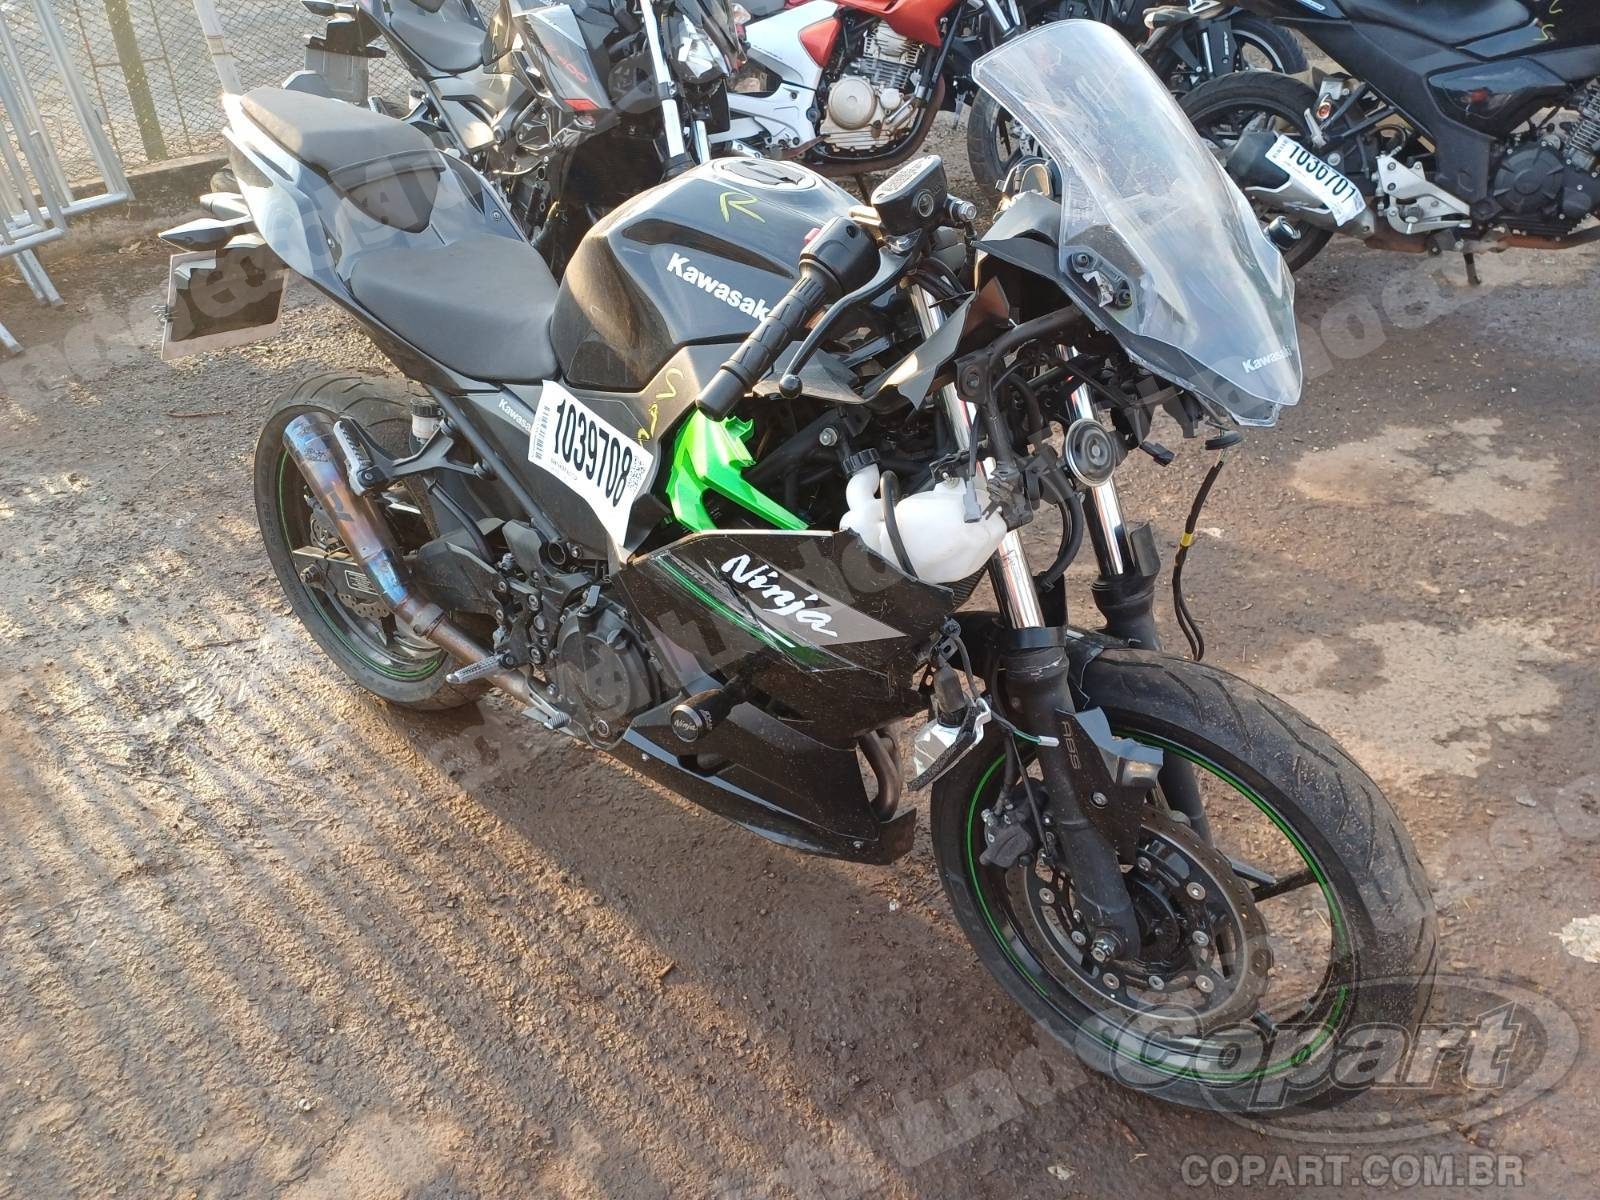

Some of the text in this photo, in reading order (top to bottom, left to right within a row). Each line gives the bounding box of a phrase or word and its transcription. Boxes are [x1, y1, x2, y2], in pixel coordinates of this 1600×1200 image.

[666, 252, 771, 323] Kawasak
[498, 398, 531, 432] Kawasa
[553, 399, 633, 507] 1039708
[720, 553, 838, 638] Ninja
[673, 719, 698, 731] Ninja
[1061, 720, 1081, 769] ABS
